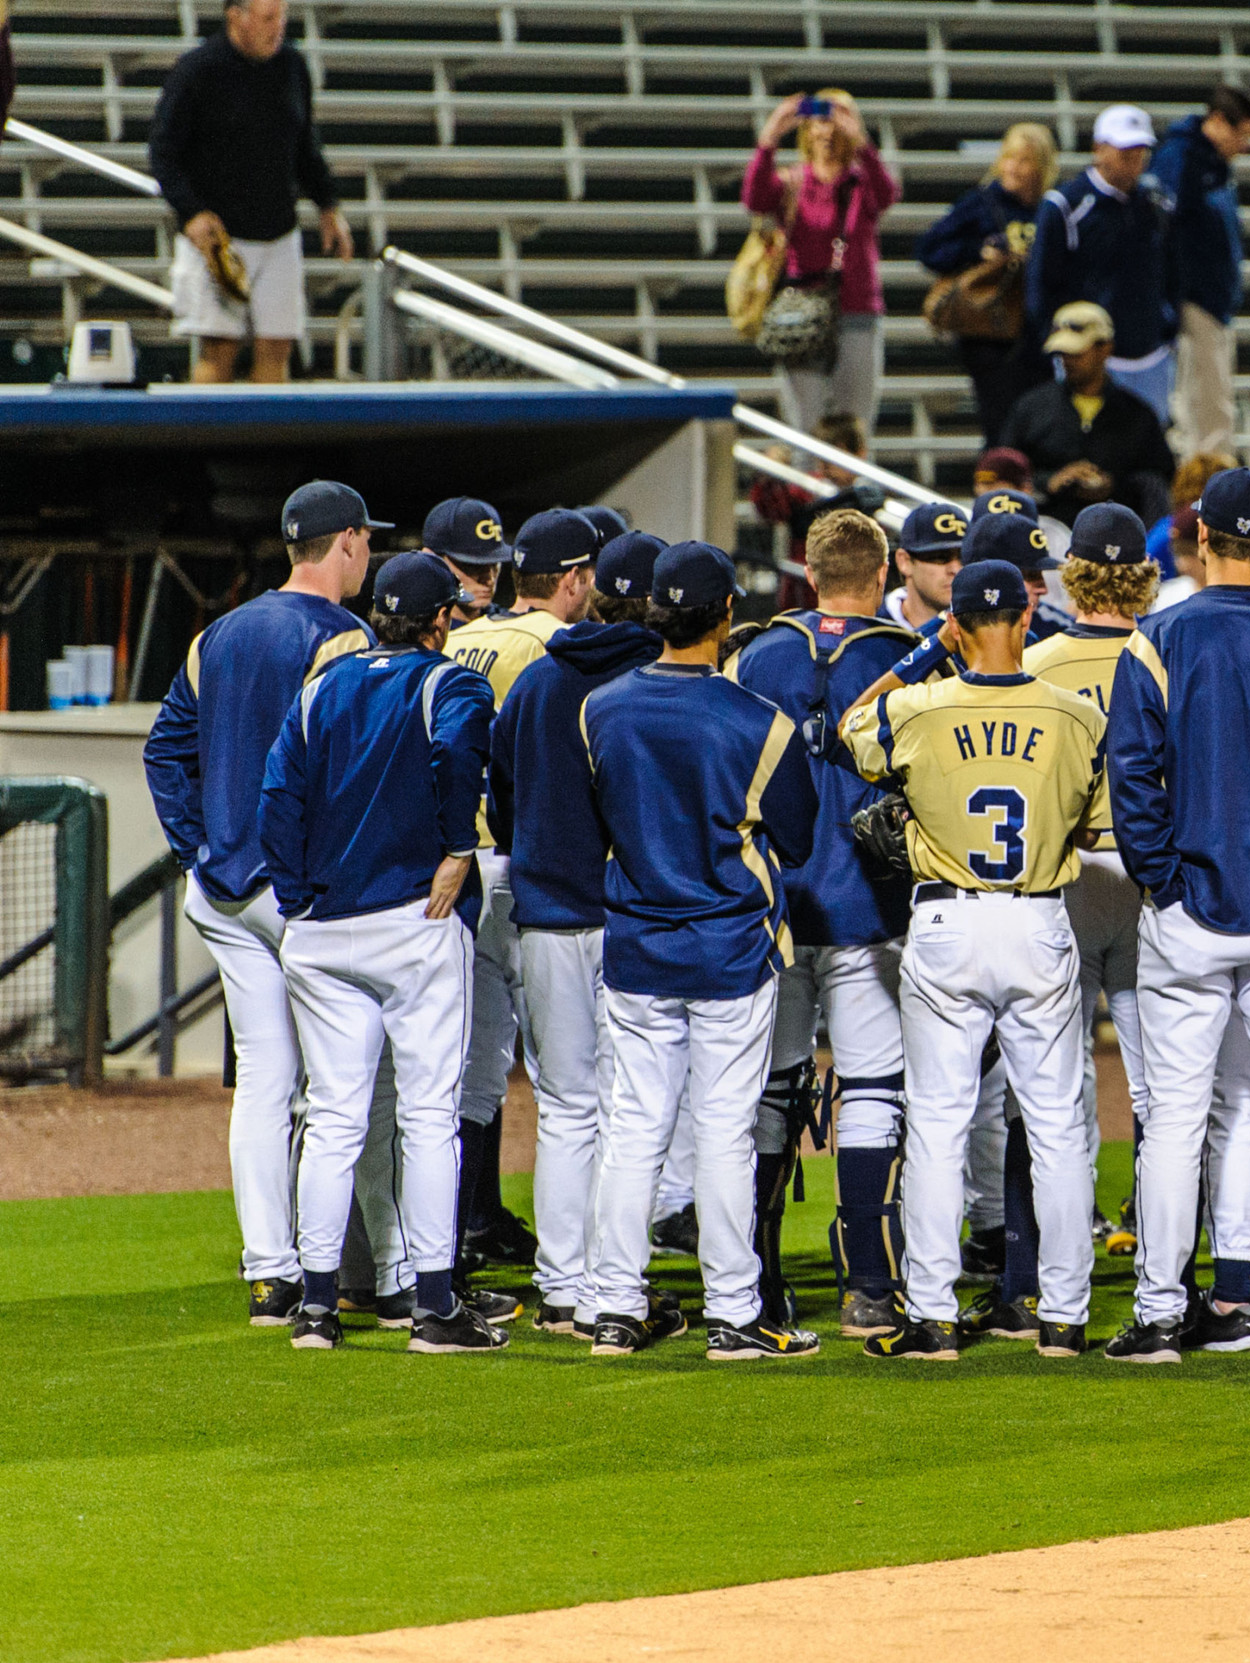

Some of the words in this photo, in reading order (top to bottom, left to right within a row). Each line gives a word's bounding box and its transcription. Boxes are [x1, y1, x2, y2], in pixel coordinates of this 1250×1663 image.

[934, 513, 967, 537] GT
[1029, 529, 1049, 550] G
[953, 721, 1044, 762] HYDE
[966, 785, 1028, 884] 3
